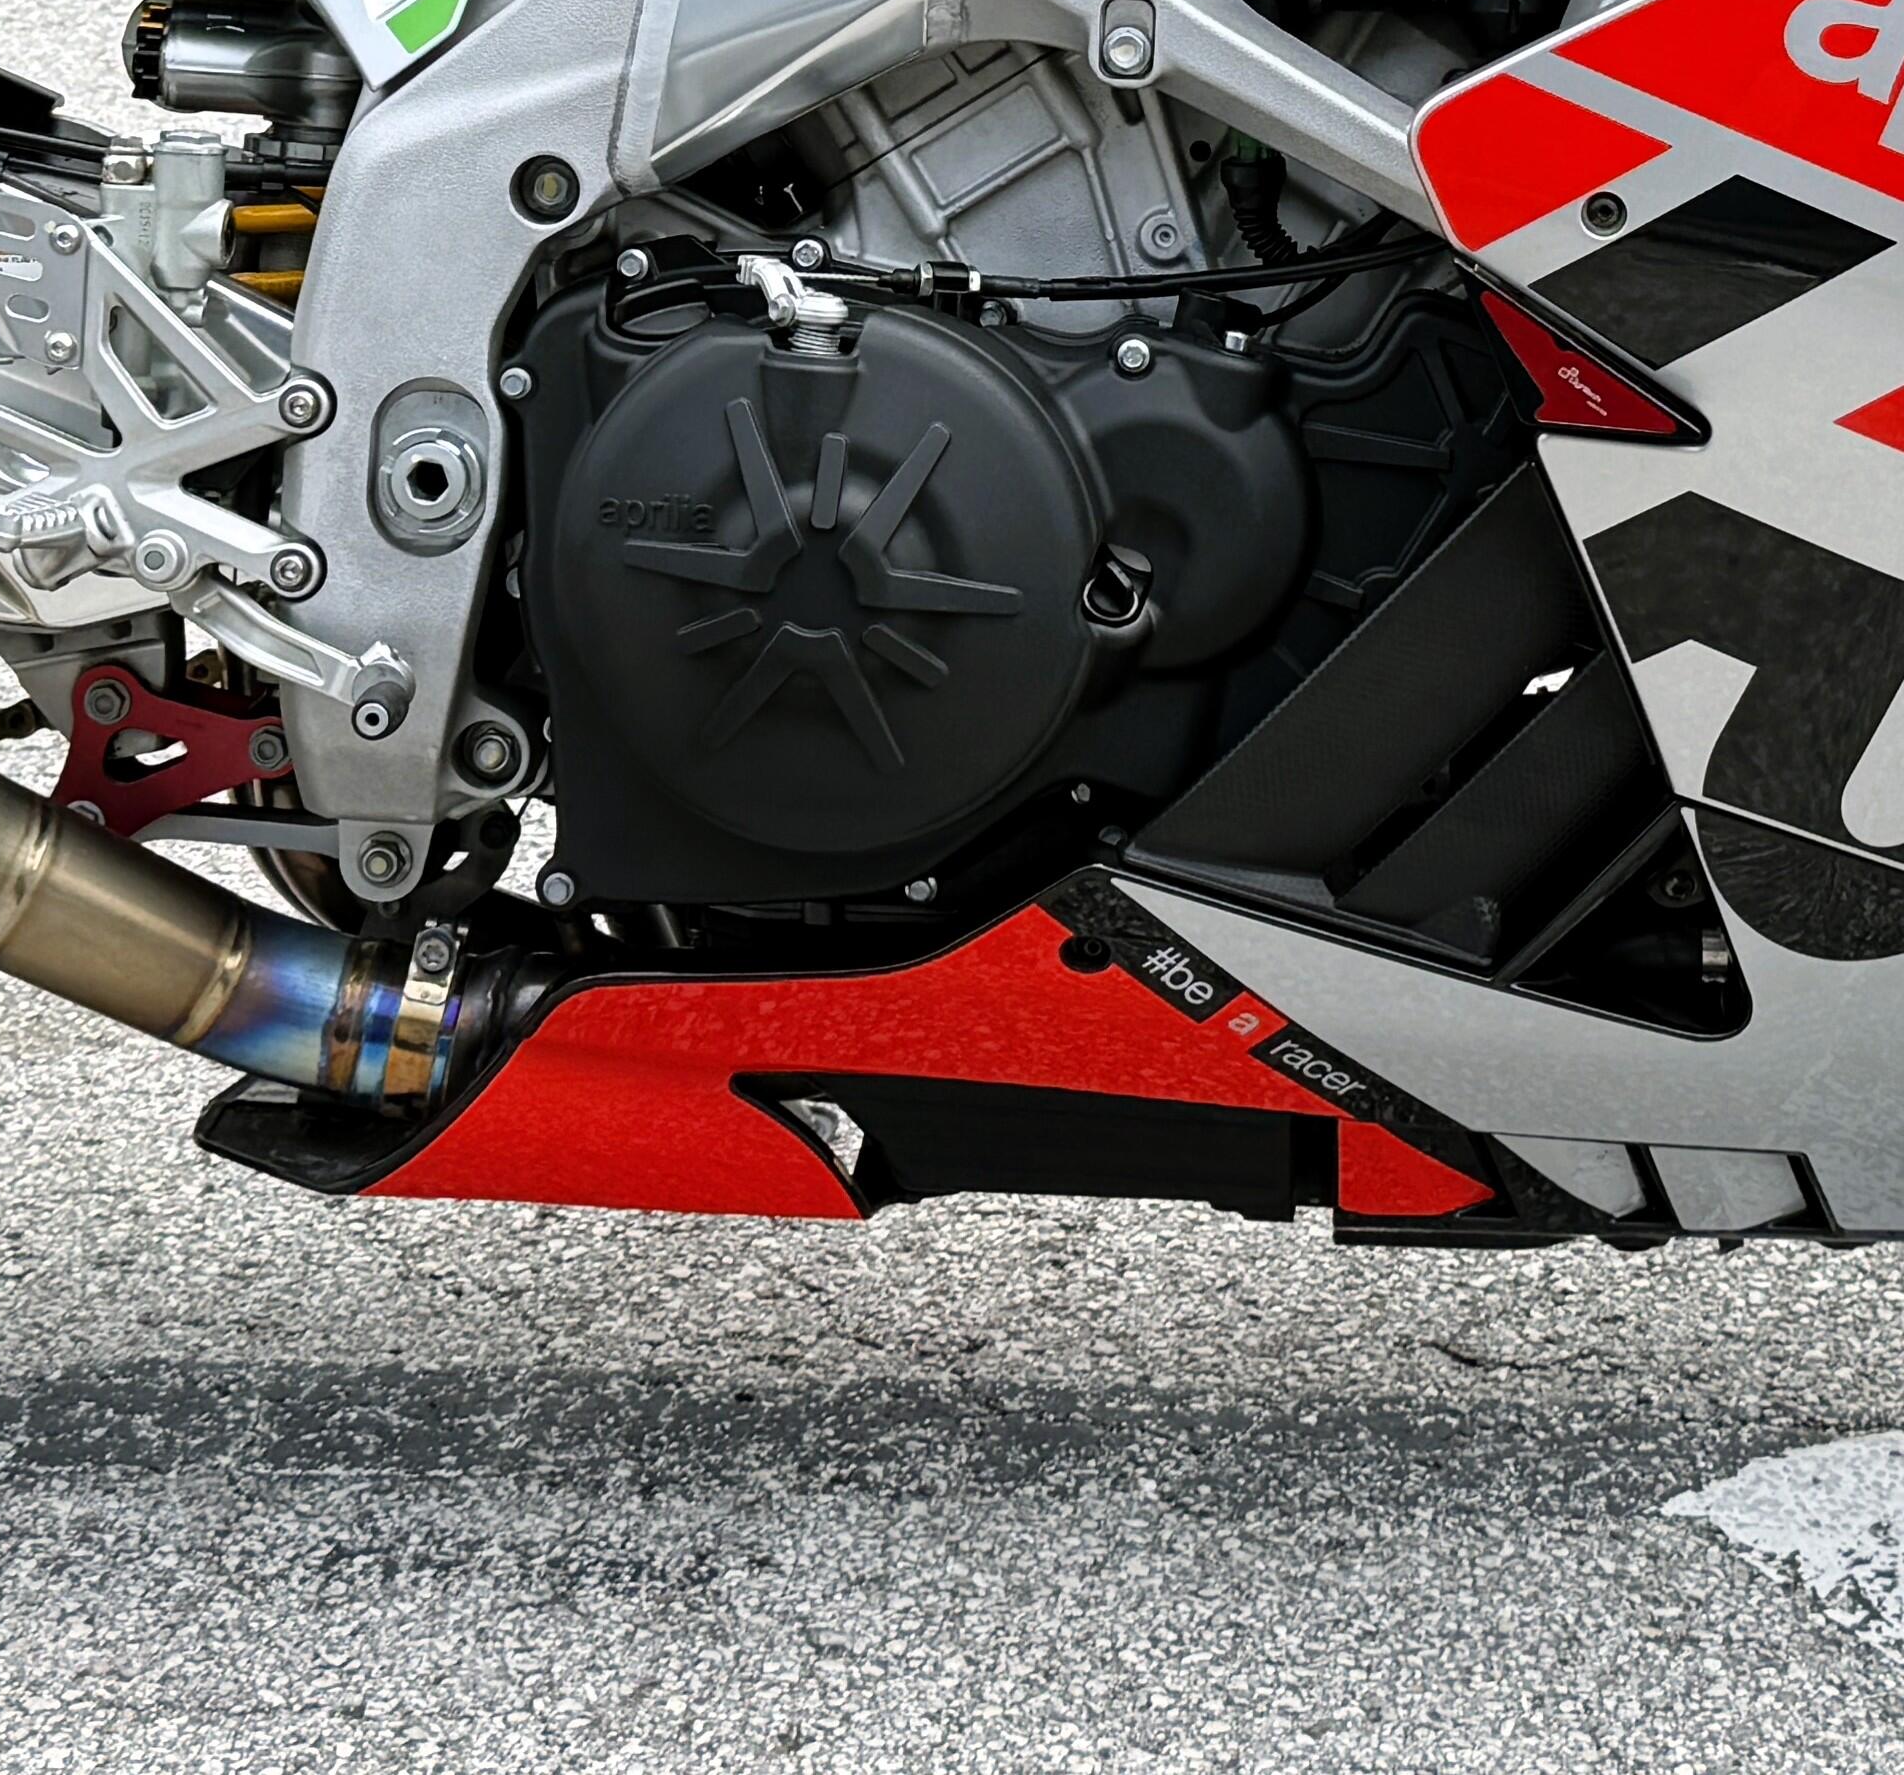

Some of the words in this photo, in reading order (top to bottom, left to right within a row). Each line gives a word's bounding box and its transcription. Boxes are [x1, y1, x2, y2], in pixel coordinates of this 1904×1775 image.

[598, 491, 716, 538] aprilia
[1141, 946, 1215, 1005] #be
[1227, 1012, 1261, 1037] a
[1268, 1038, 1368, 1096] racer
